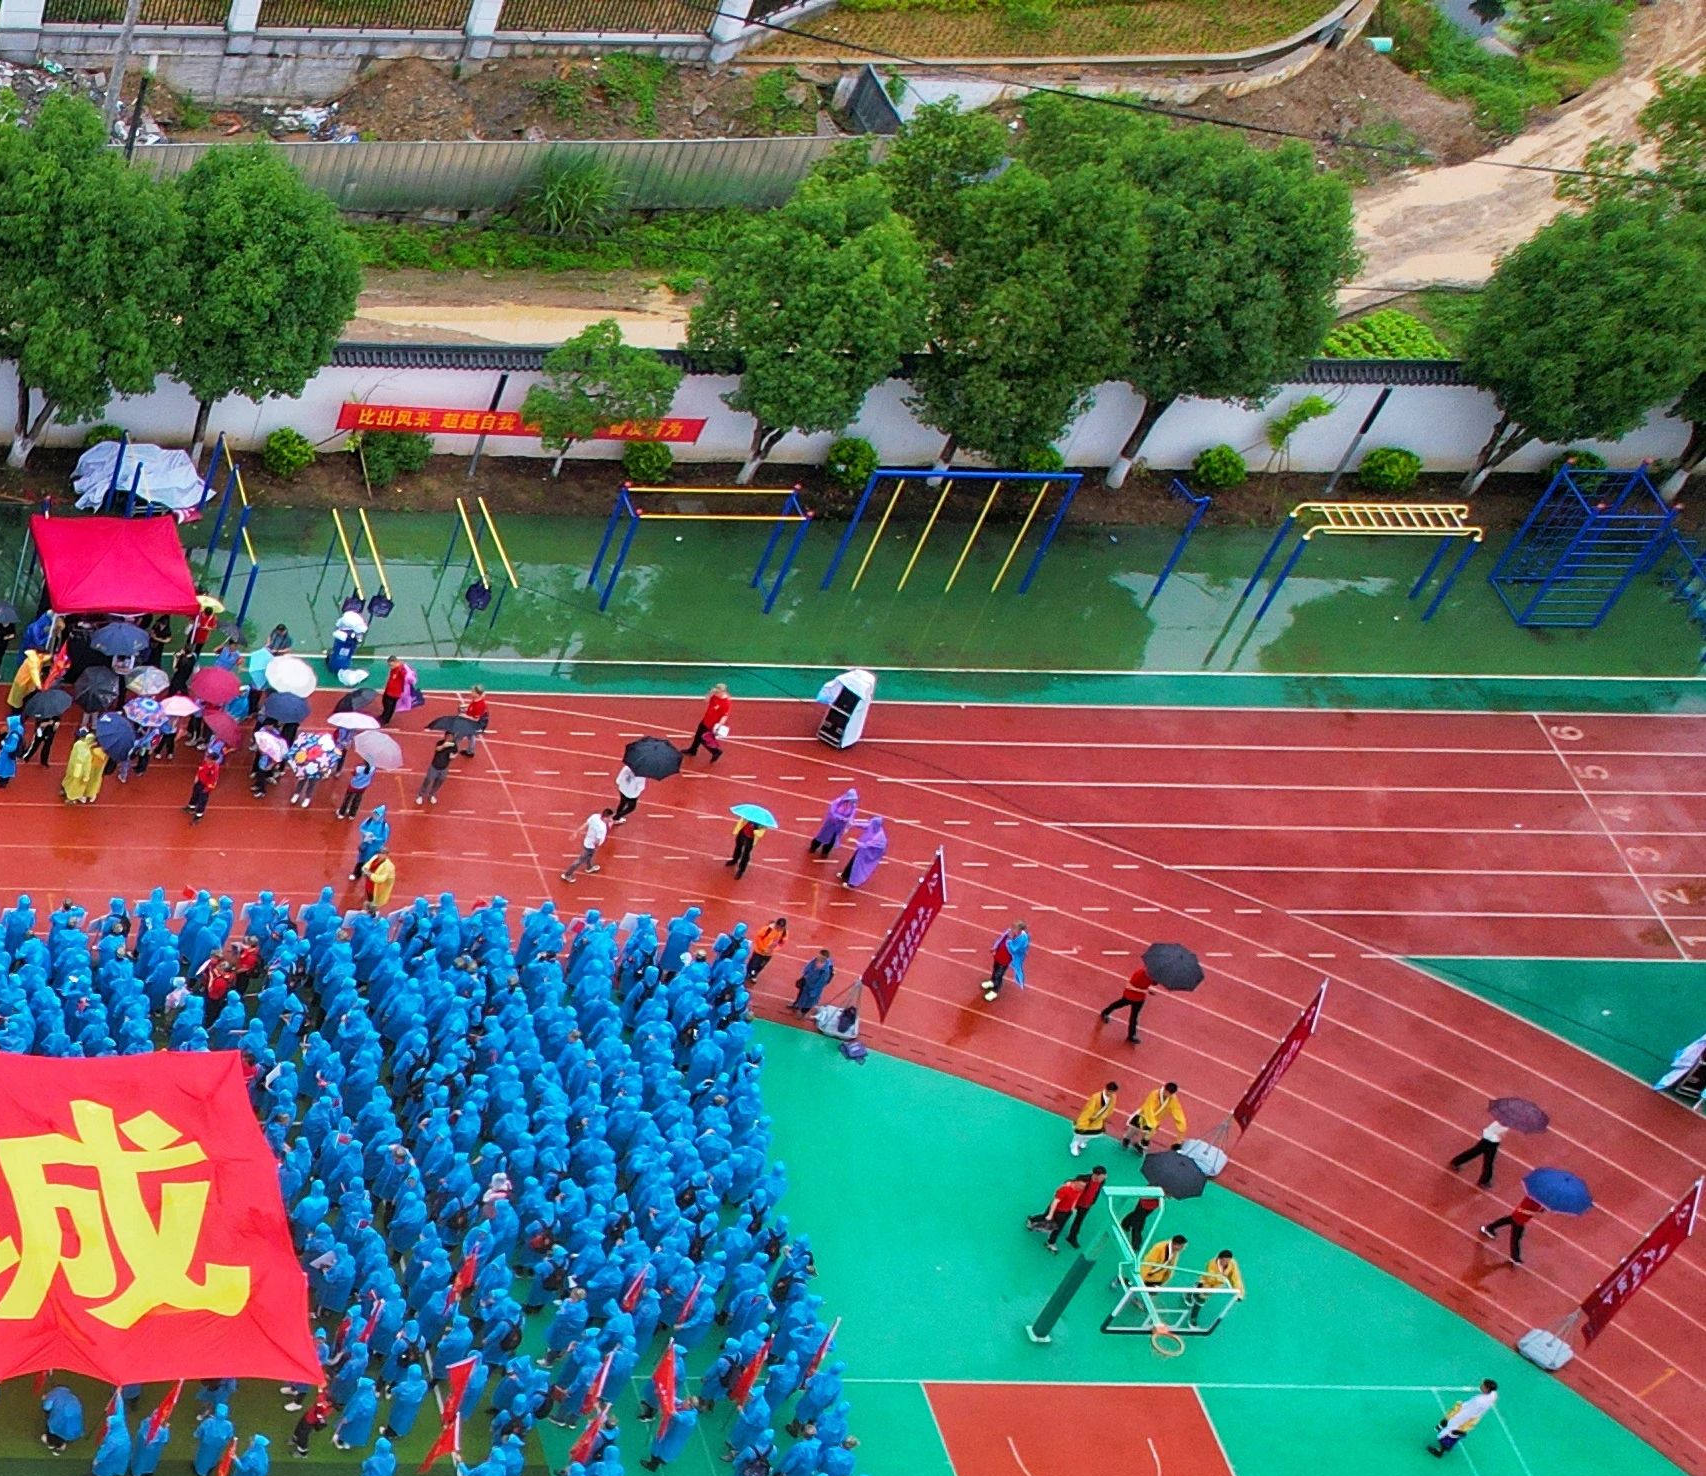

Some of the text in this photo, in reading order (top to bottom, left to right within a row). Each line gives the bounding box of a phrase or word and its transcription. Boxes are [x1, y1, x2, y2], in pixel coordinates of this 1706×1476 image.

[358, 408, 432, 428] 比出风采
[441, 412, 517, 432] 超越自我
[1550, 725, 1584, 741] 6
[1573, 765, 1609, 780] 5
[1653, 889, 1690, 905] 2
